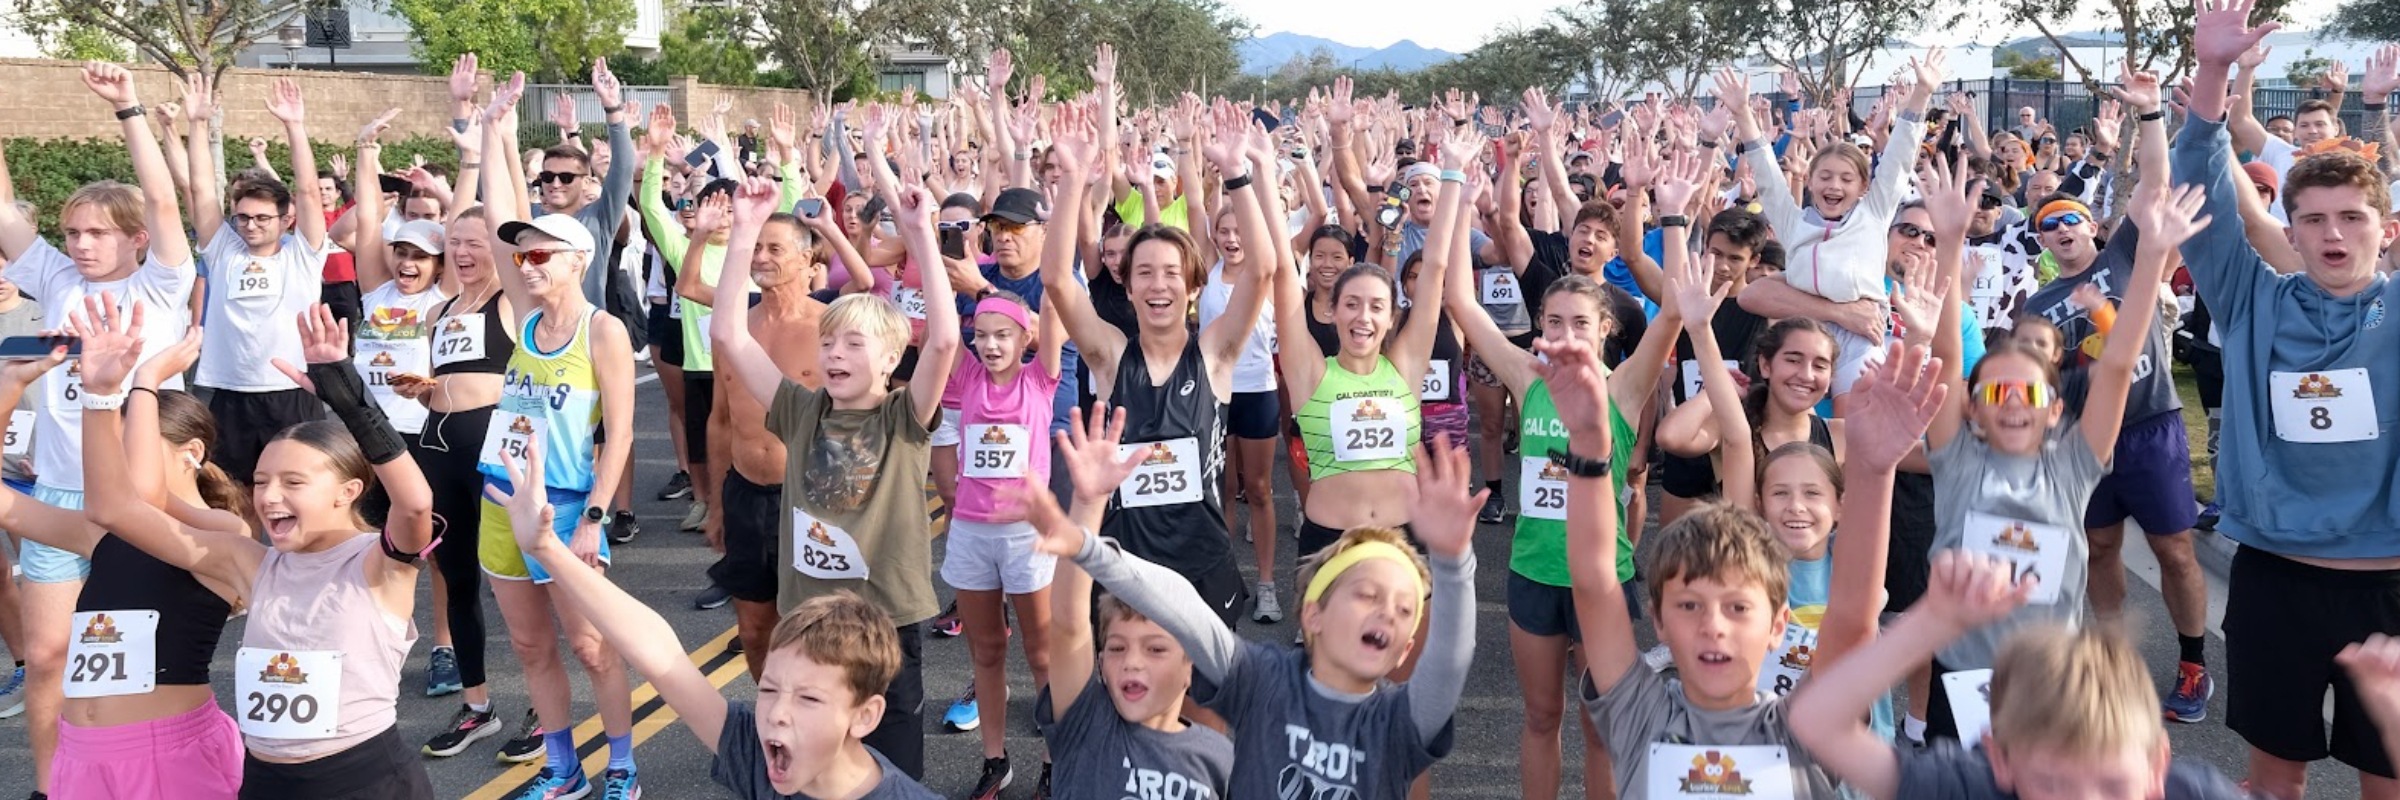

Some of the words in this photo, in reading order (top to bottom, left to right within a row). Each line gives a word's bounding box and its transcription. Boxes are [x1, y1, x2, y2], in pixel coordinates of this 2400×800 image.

[239, 277, 269, 291] 198
[1491, 288, 1514, 299] 691
[1973, 275, 1996, 290] EY
[2042, 268, 2112, 326] TT
[437, 336, 473, 357] 472
[64, 382, 84, 401] 6
[1694, 380, 1705, 395] 7
[1524, 417, 1548, 437] CAL
[2309, 406, 2333, 430] 8
[1345, 427, 1395, 450] 252
[974, 449, 1017, 469] 557
[1134, 469, 1188, 496] 253
[1534, 486, 1568, 510] 25
[803, 544, 851, 572] 823
[70, 651, 128, 683] 291
[1773, 674, 1799, 697] 8
[246, 690, 319, 724] 290
[1285, 723, 1367, 785] TROT
[1122, 756, 1211, 800] TROT
